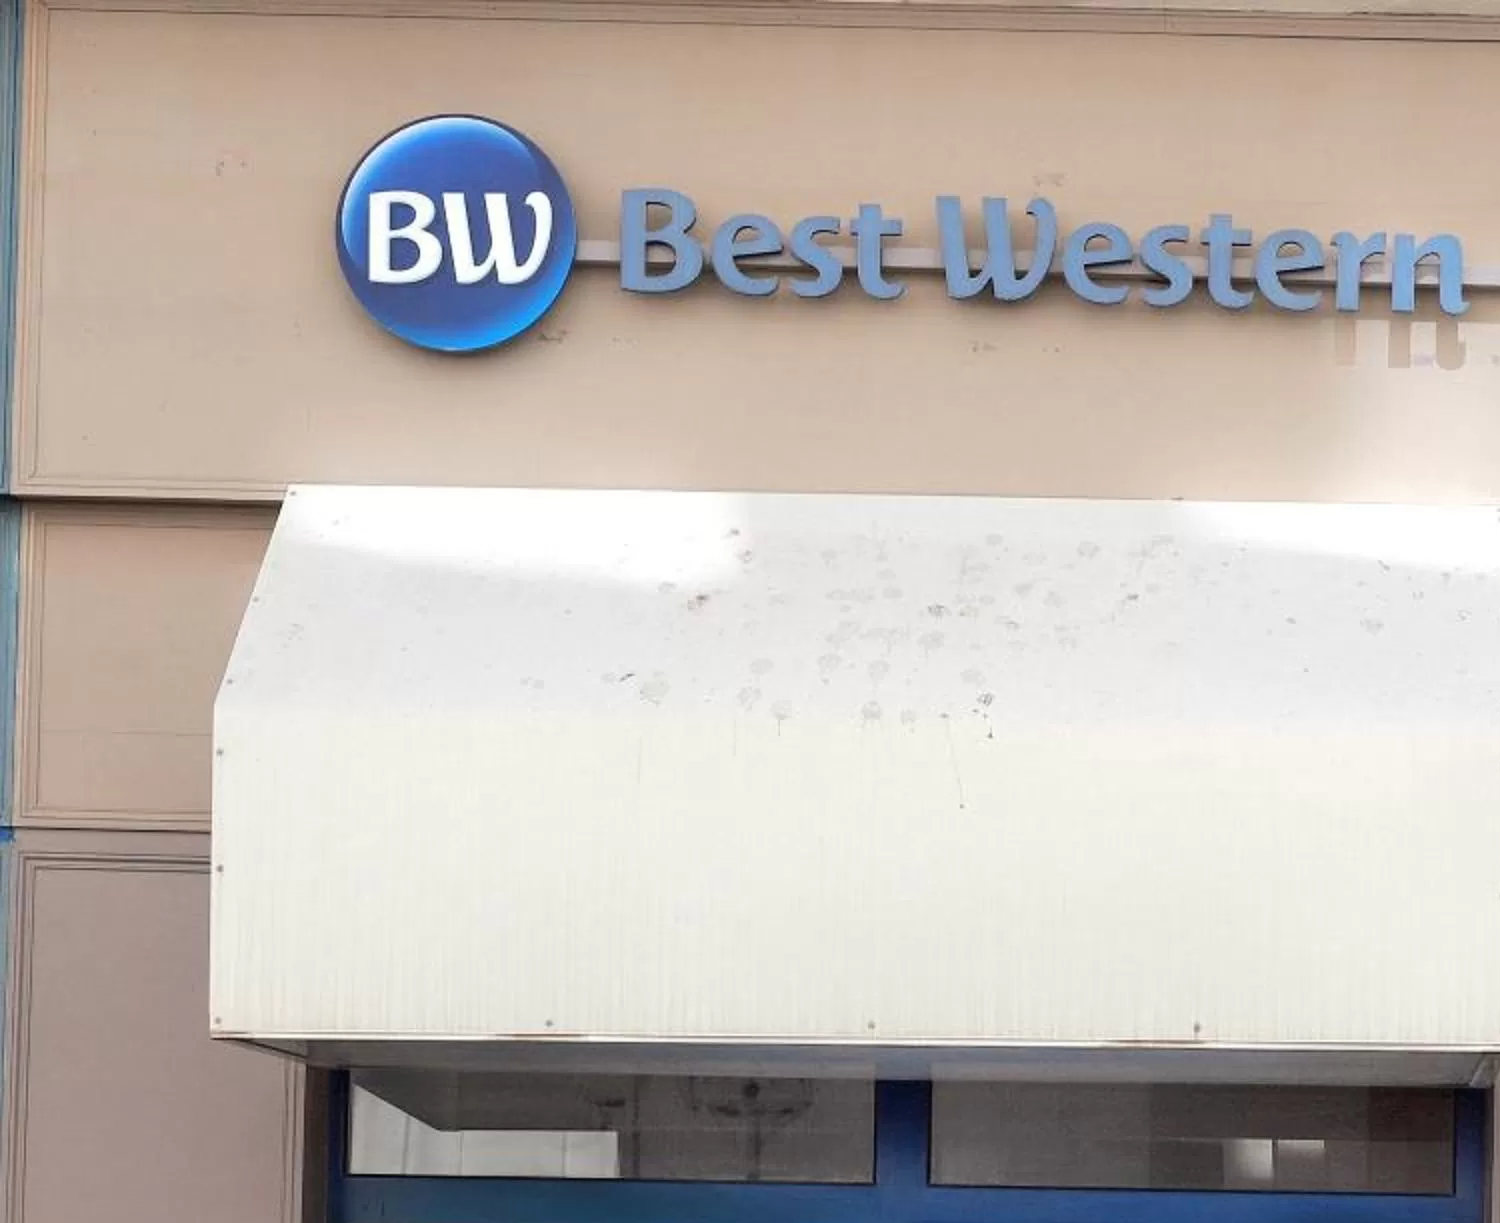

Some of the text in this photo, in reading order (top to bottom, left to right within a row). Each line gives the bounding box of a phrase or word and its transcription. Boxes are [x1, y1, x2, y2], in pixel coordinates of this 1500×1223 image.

[367, 190, 553, 286] BW
[619, 187, 1470, 317] Best Western
